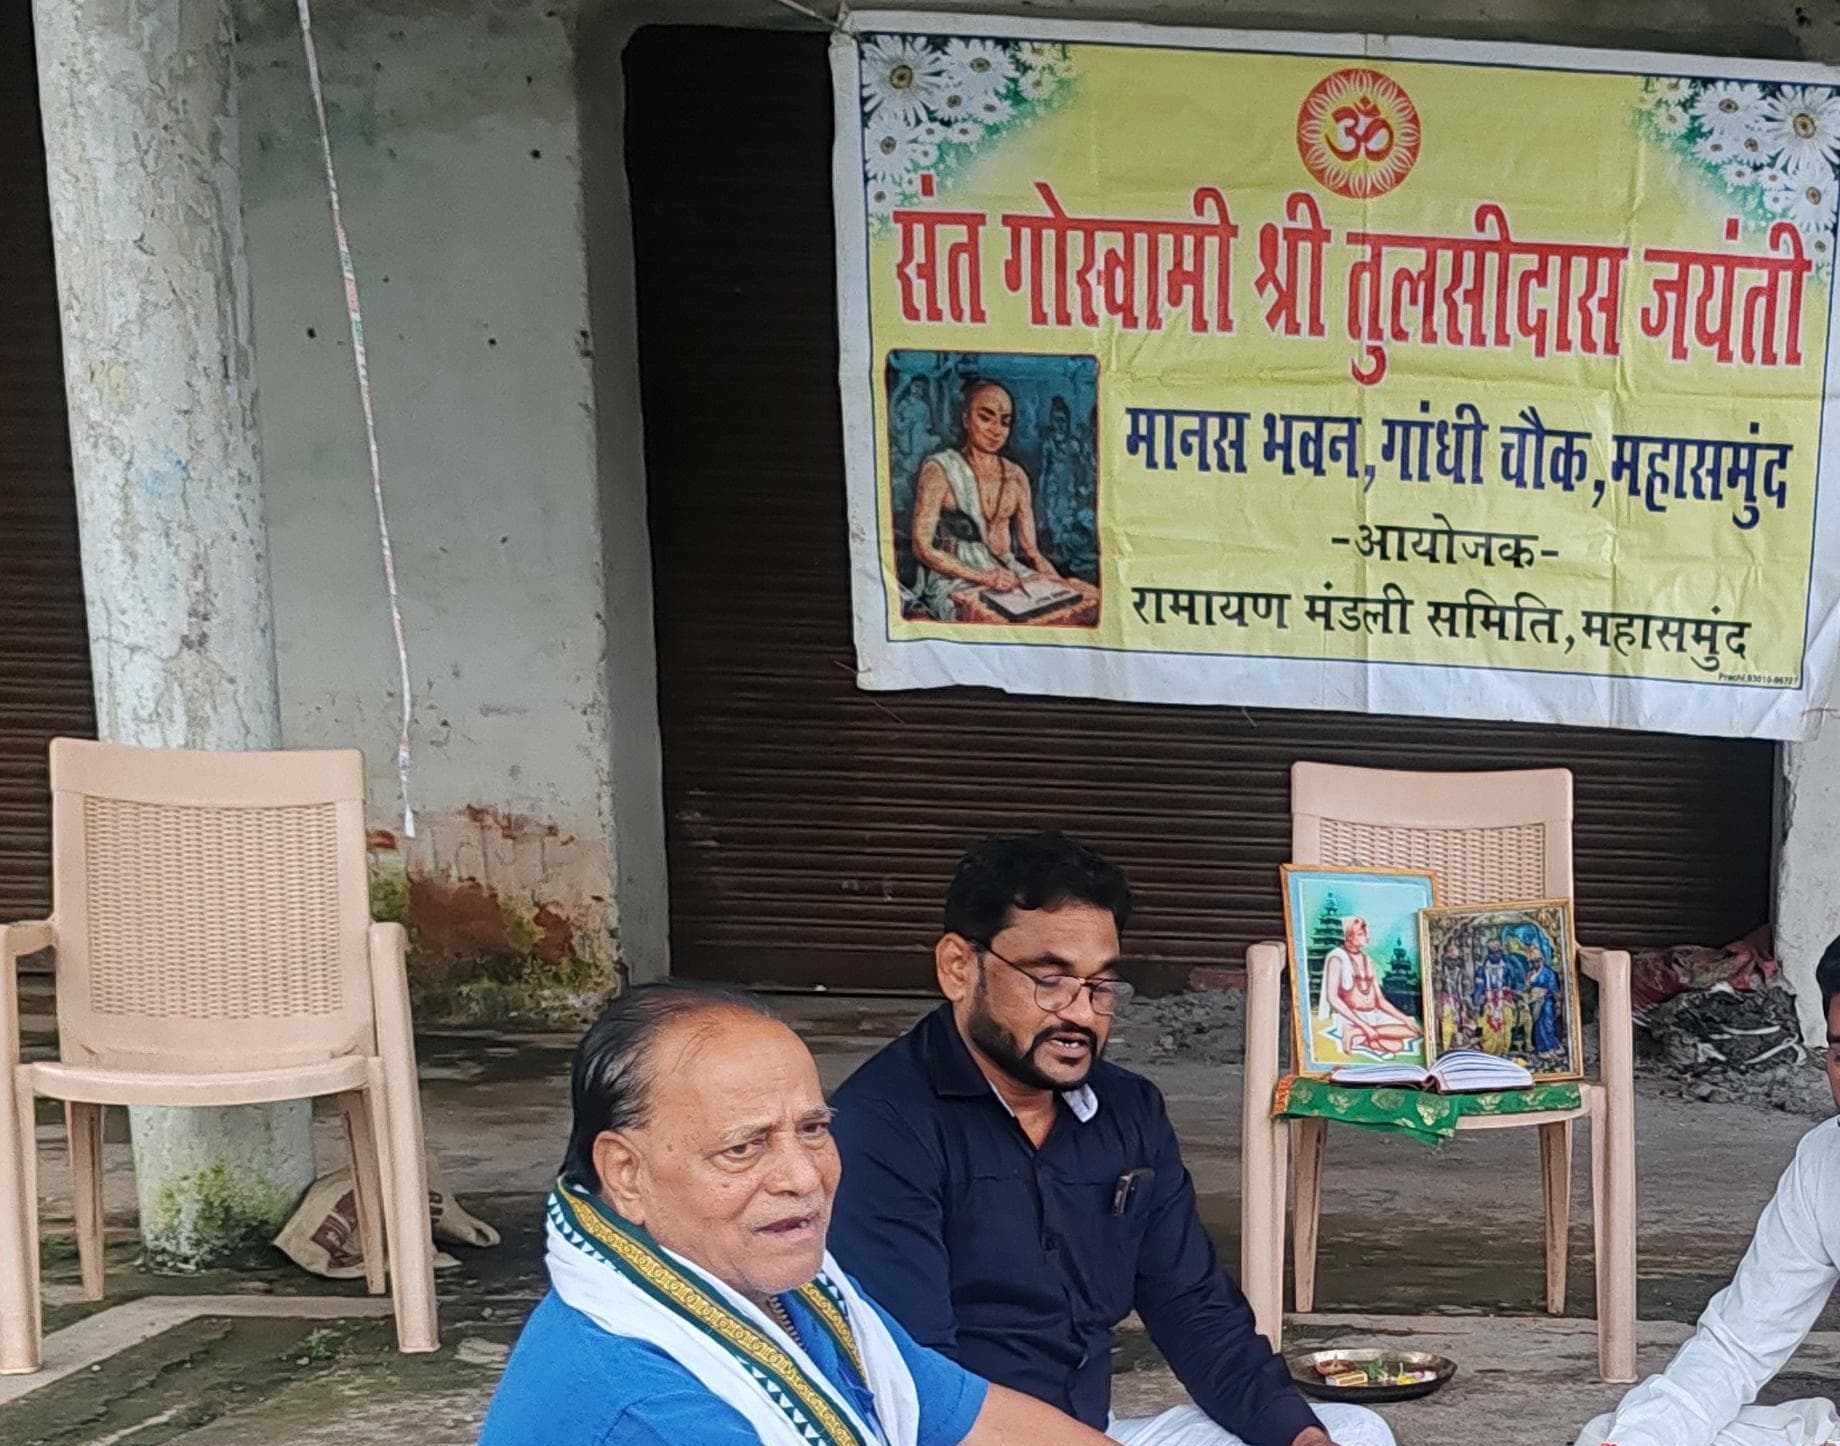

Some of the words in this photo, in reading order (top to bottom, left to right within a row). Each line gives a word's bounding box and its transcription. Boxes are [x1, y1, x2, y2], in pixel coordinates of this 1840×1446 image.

[892, 174, 987, 324] संत
[1001, 181, 1239, 332] गोस्वामी
[1255, 191, 1332, 337] श्री
[1345, 202, 1630, 386] तुलसीदास
[1640, 217, 1813, 366] जयंती
[1125, 407, 1251, 474] मानस
[1131, 587, 1292, 629] रामायण
[1303, 581, 1415, 635] मंडली
